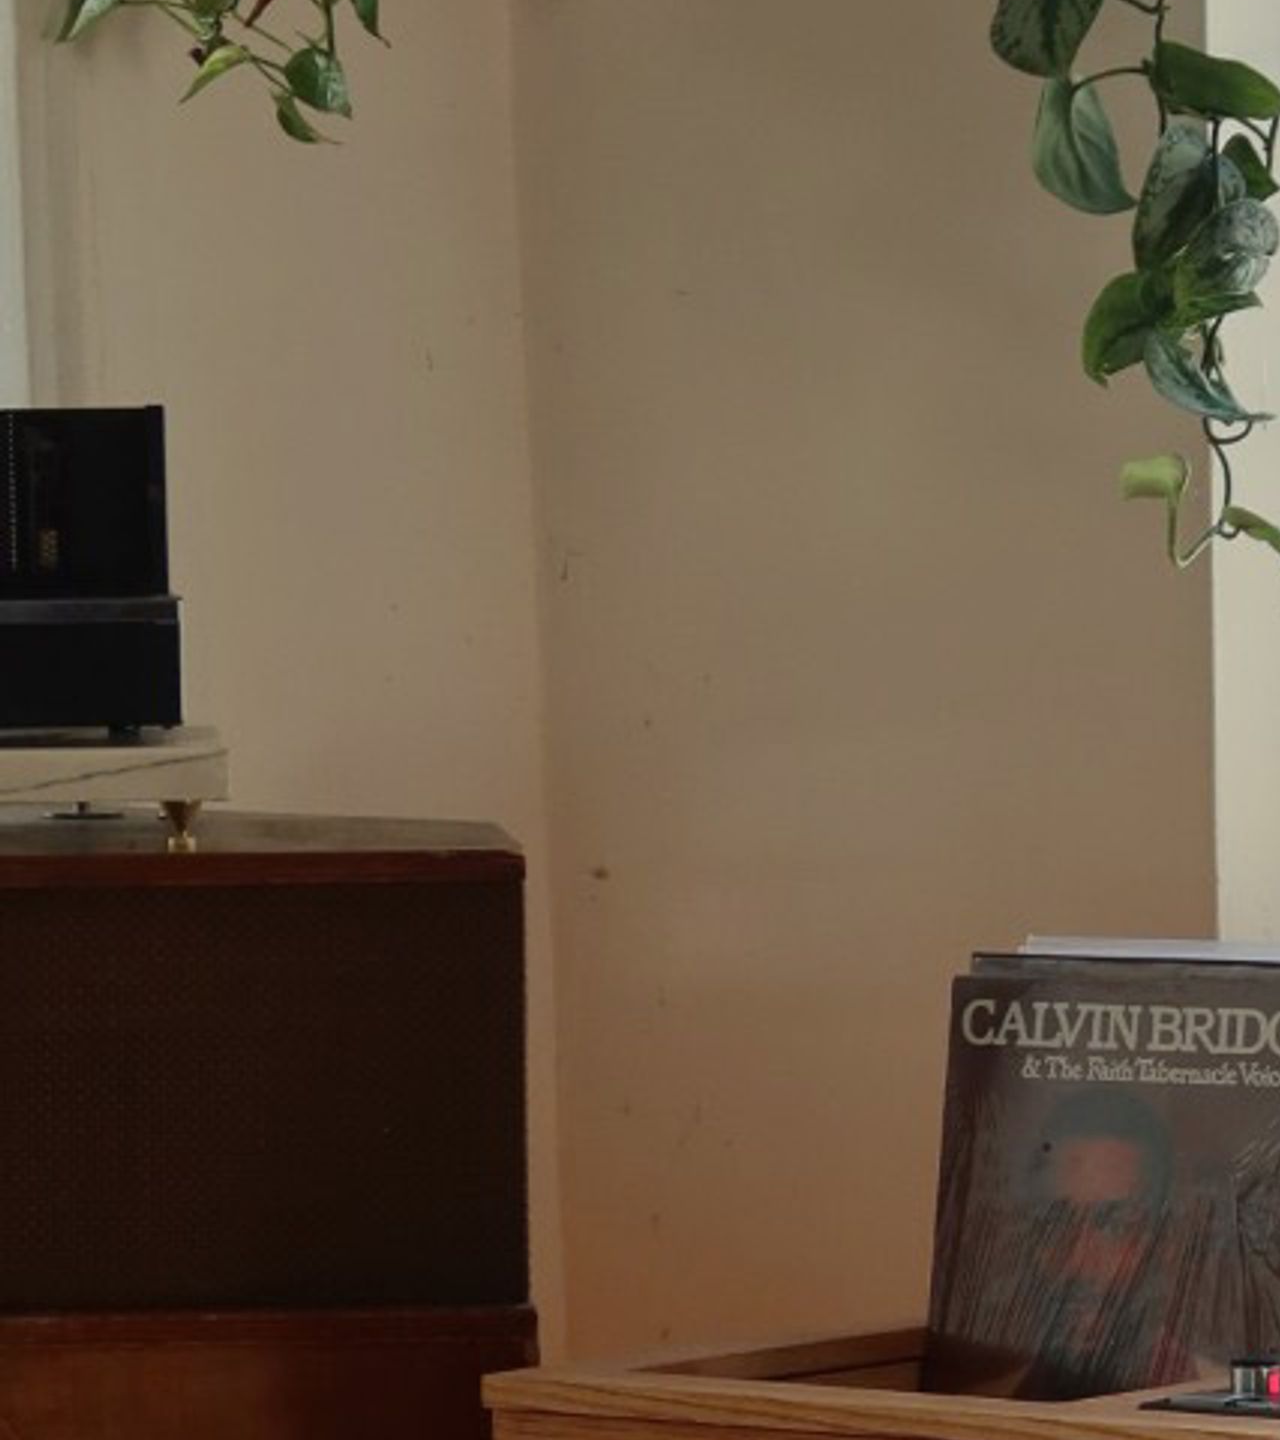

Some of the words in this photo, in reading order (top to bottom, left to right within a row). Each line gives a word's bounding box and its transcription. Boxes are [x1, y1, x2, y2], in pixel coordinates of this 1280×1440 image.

[961, 998, 1144, 1051] CALVIN
[1021, 1055, 1041, 1079] &
[1044, 1056, 1085, 1080] The
[1087, 1057, 1134, 1083] Faith
[1137, 1058, 1237, 1086] Tabernacle
